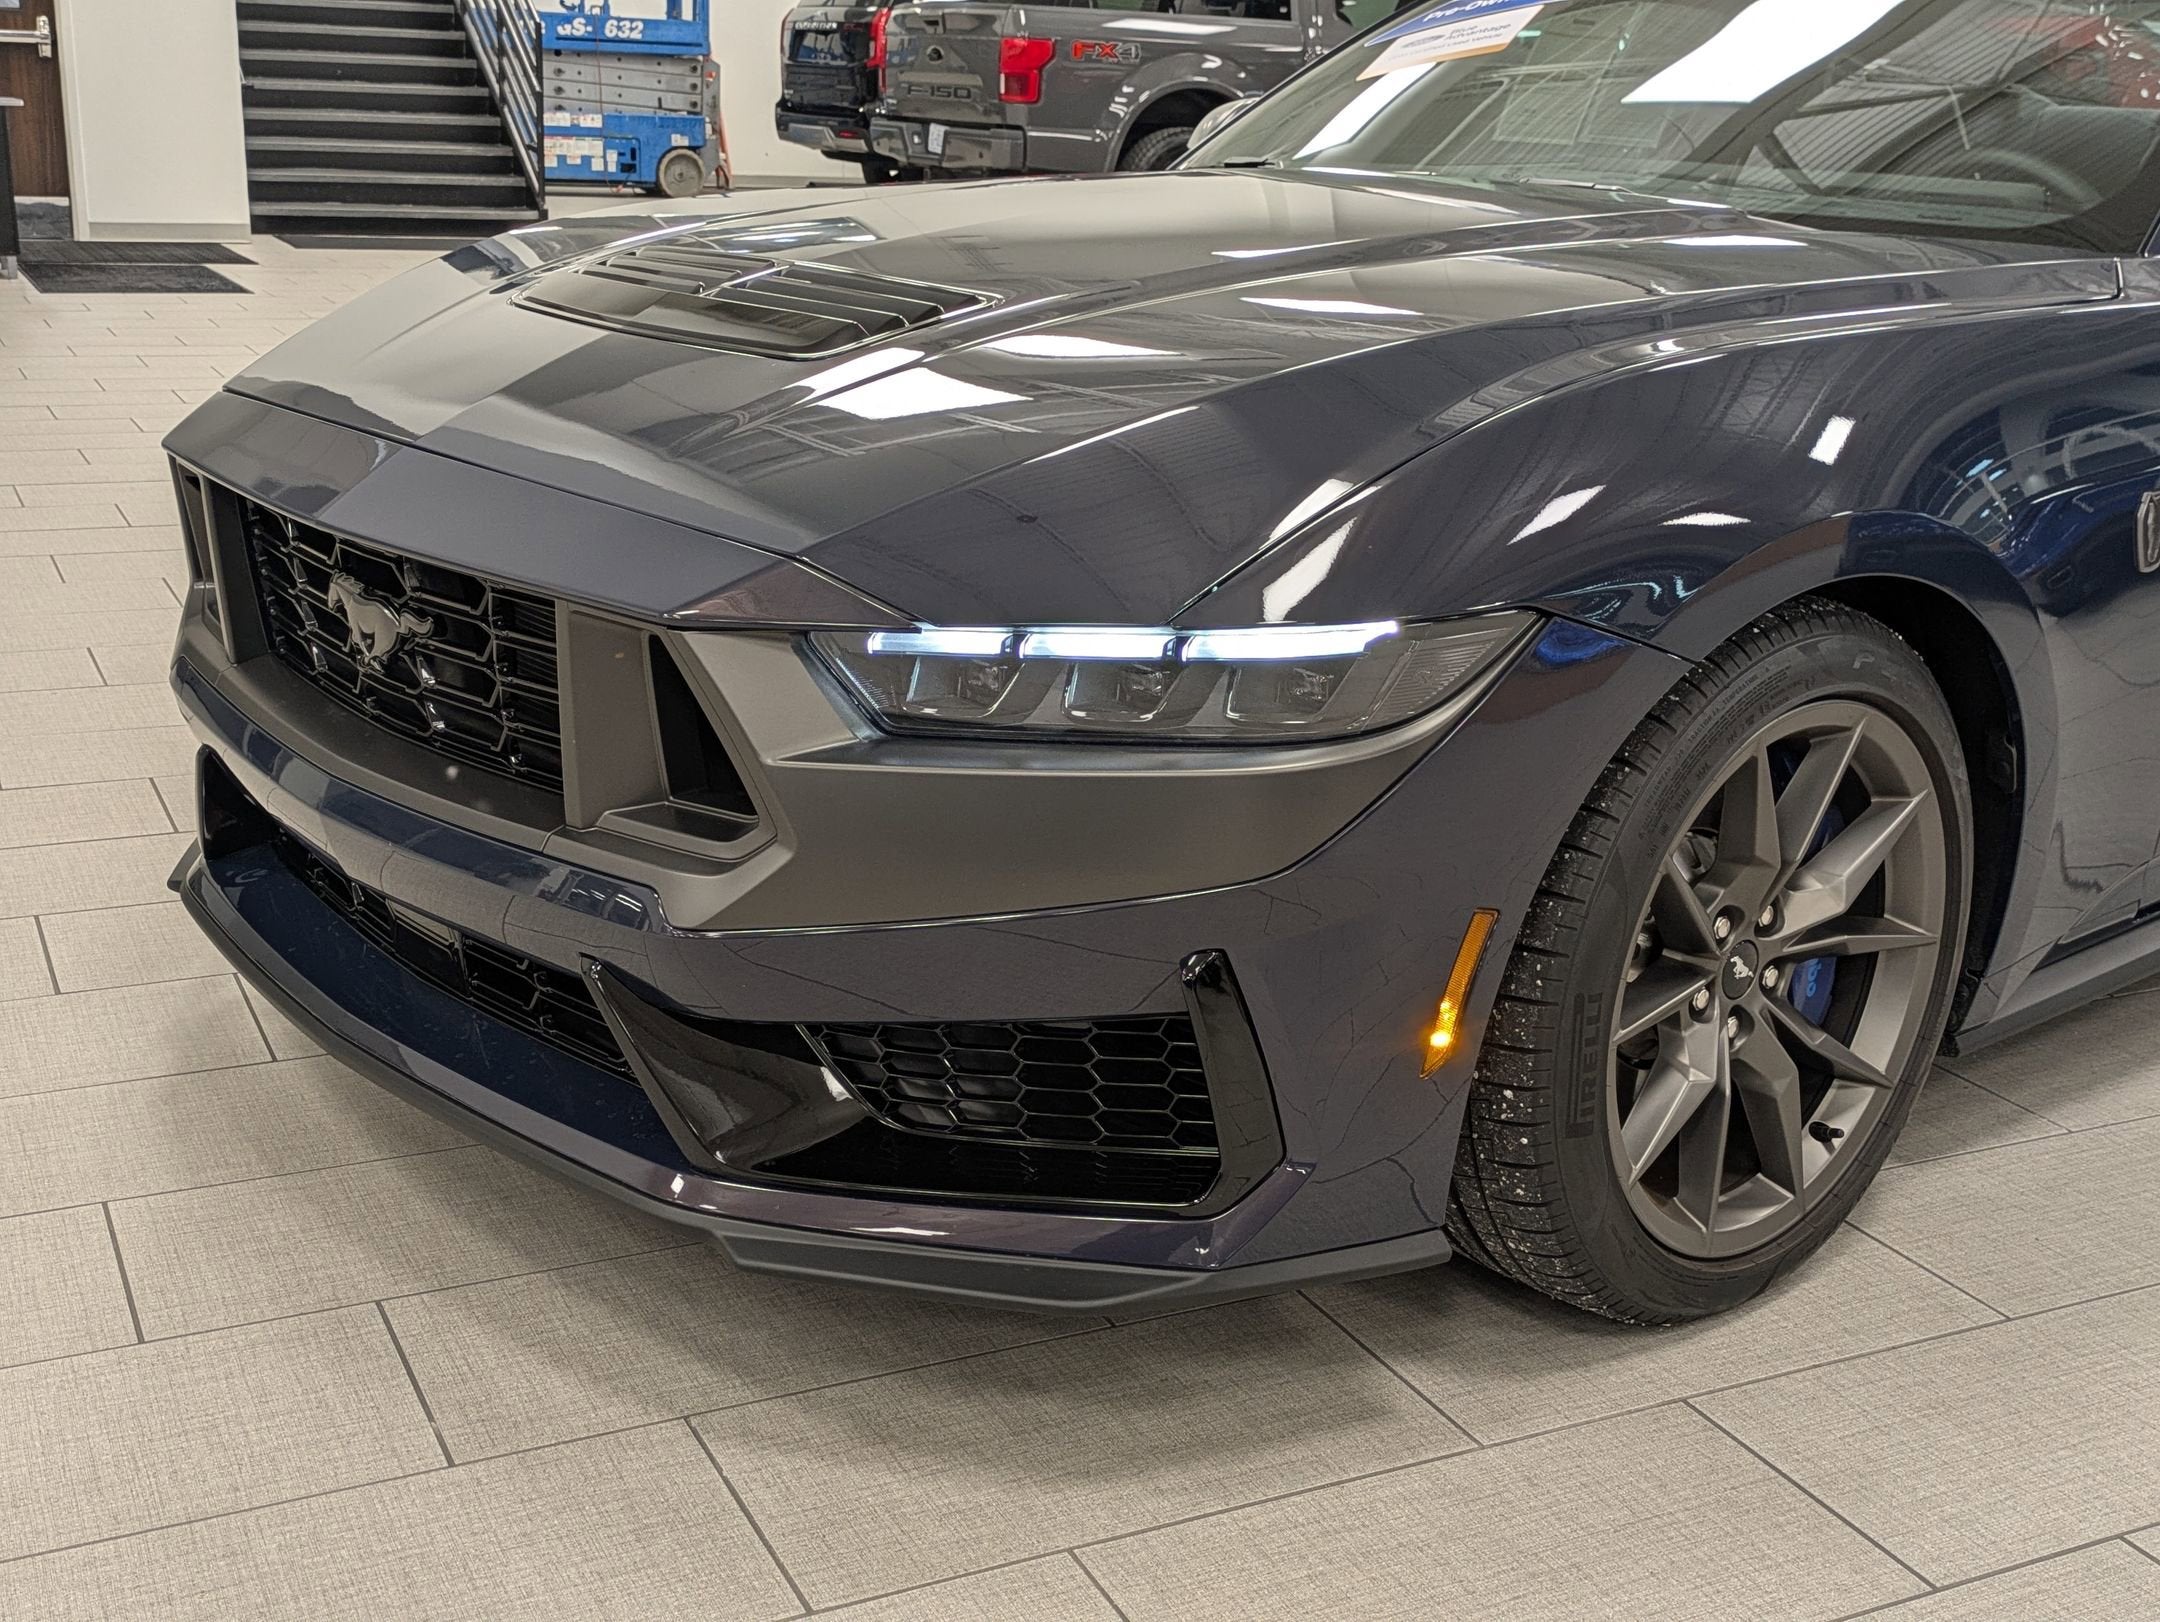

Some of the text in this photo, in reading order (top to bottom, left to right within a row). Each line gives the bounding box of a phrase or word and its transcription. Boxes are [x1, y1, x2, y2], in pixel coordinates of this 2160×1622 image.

[604, 19, 644, 39] 632
[1071, 40, 1140, 62] FX4
[907, 85, 971, 99] F-150
[1564, 992, 1603, 1140] PIRELLI
